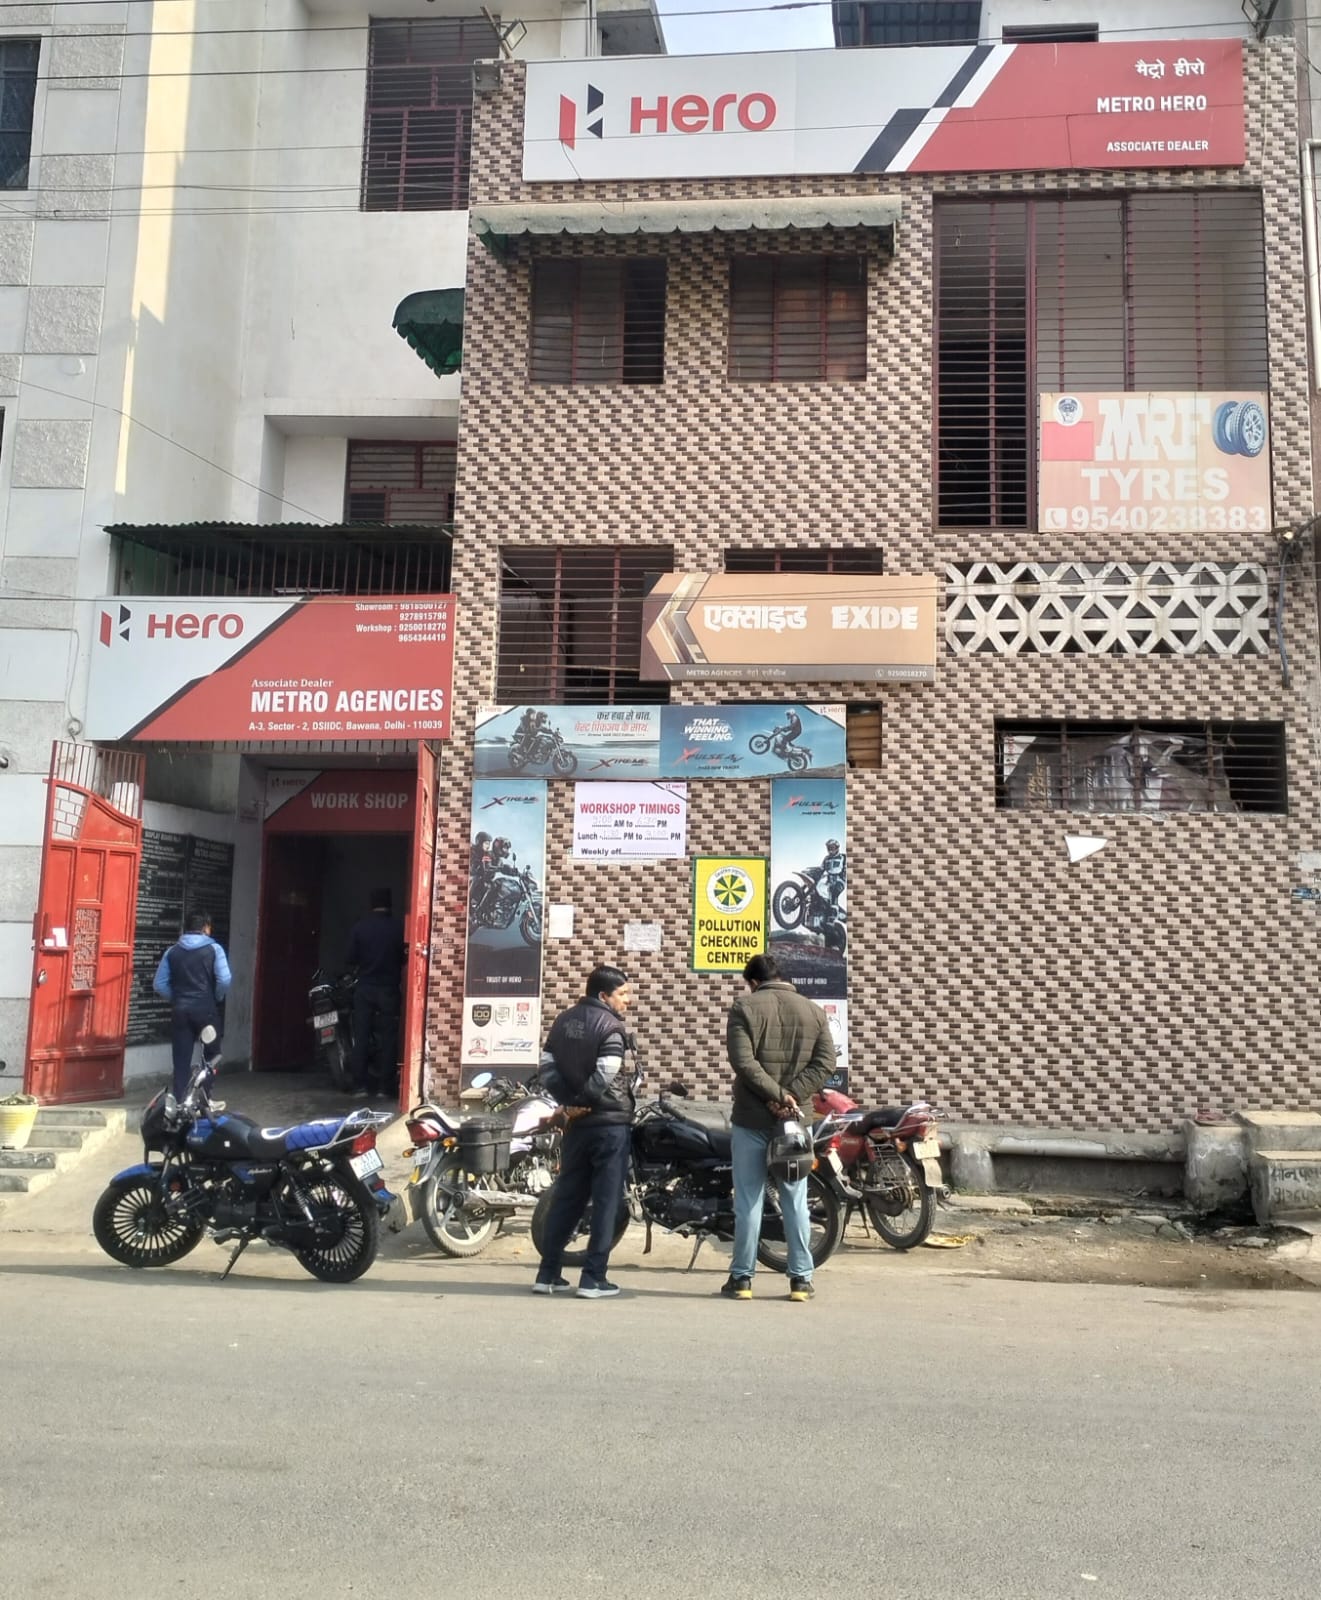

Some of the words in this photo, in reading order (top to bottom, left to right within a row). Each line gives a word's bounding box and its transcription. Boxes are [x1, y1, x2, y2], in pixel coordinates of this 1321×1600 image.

[1173, 57, 1205, 76] हीरो
[1097, 96, 1154, 112] METRO
[1161, 95, 1206, 111] HERO
[1107, 141, 1164, 152] ASSOCIATE
[1168, 140, 1208, 151] DEALER
[1095, 398, 1211, 461] MRF
[1081, 467, 1230, 501] TYRES
[1071, 506, 1266, 530] 9540238383
[831, 605, 919, 630] EXIDE
[355, 624, 392, 633] Workshop
[686, 669, 709, 677] METRO
[252, 678, 298, 688] Associate
[301, 678, 334, 687] Dealer
[251, 691, 328, 713] METRO
[335, 689, 443, 712] AGENCIES
[268, 721, 295, 730] Sector
[346, 721, 382, 731] Bawana,
[384, 720, 405, 730] Delhi
[413, 720, 442, 729] 110039
[692, 718, 720, 726] THAT
[684, 725, 729, 734] WINNING
[311, 793, 359, 808] WORK
[364, 792, 408, 808] SHOP
[580, 803, 636, 814] WORKSHOP
[639, 803, 681, 814] TIMINGS
[613, 820, 624, 828] AM
[626, 820, 633, 828] to
[657, 820, 667, 828] PM
[577, 832, 597, 840] Lunch
[623, 832, 633, 840] PM
[635, 832, 642, 840] to
[670, 832, 681, 840] PM
[581, 848, 608, 856] Weekly
[698, 919, 761, 932] POLLUTION
[700, 935, 758, 948] CHECKING
[707, 951, 751, 964] CENTRE
